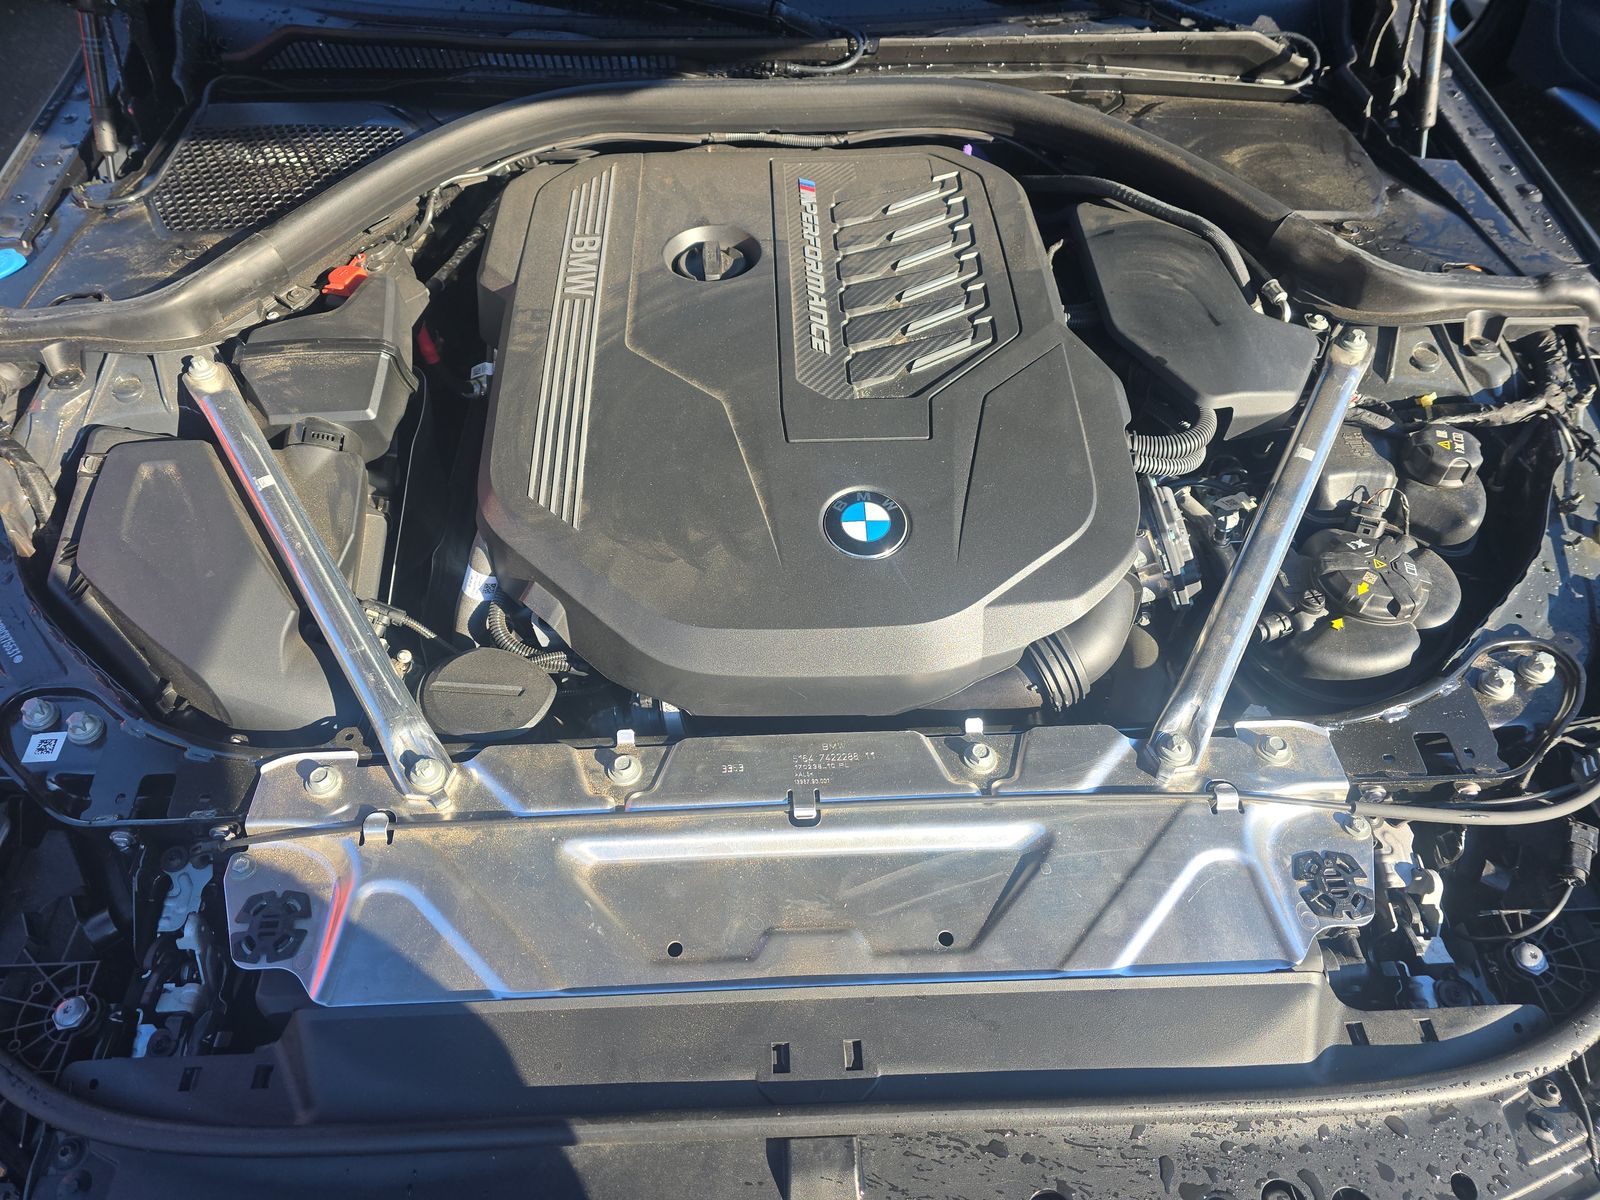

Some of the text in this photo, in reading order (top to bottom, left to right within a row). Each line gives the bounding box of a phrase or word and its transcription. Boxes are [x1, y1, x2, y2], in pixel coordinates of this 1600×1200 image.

[563, 236, 602, 297] BMW
[832, 492, 898, 512] BMW
[822, 742, 847, 751] BMW
